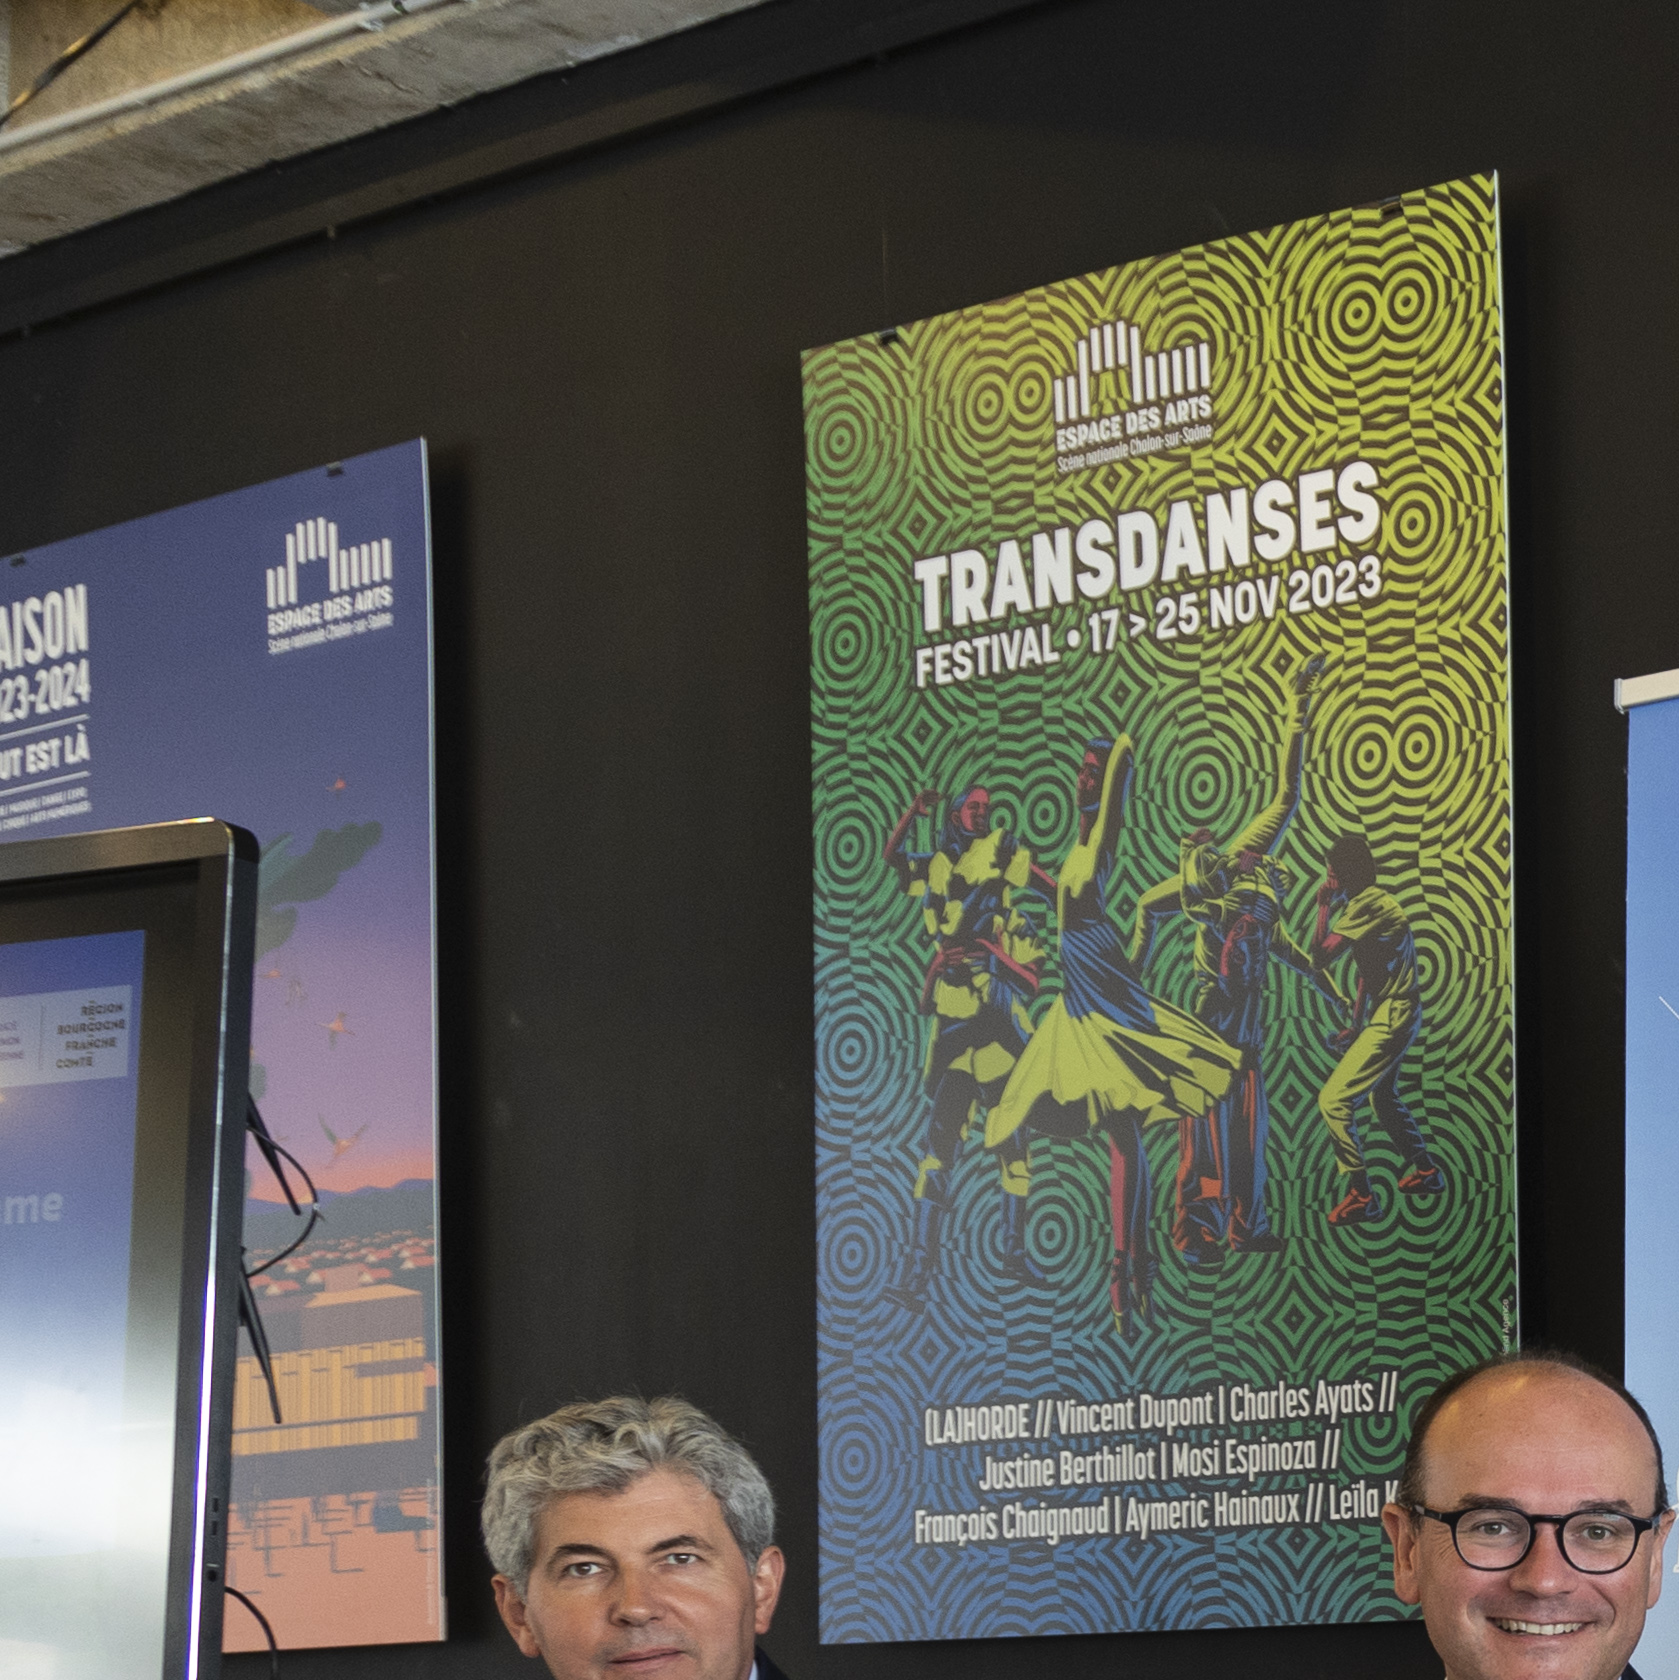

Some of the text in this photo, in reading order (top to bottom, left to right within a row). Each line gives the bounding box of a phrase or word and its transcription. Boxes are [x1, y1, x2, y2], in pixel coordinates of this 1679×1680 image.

[1056, 394, 1212, 451] ESPACE DES ARTS
[1057, 424, 1212, 473] Scène nationale Chalon-sur-Saône
[915, 461, 1381, 632] TRANSDANSES
[267, 585, 394, 635] ESPACE DES ARTS
[916, 624, 1059, 688] FESTIVAL
[1089, 608, 1119, 652] 17
[1155, 598, 1200, 641] 25
[1209, 575, 1281, 629] NOV
[1289, 555, 1382, 613] 2023
[25, 737, 62, 775] EST
[64, 723, 90, 765] LÀ
[1056, 1398, 1134, 1435] Vincent
[1140, 1392, 1213, 1436] Dupont
[1230, 1380, 1310, 1423] Charles
[1314, 1379, 1374, 1424] Ayats
[979, 1453, 1054, 1490] Justine
[1060, 1443, 1156, 1485] Berthillot
[1172, 1439, 1220, 1478] Mosi
[1225, 1436, 1316, 1482] Espinoza
[915, 1506, 998, 1547] François
[1002, 1496, 1109, 1545] Chaignaud
[1125, 1493, 1209, 1540] Aymeric
[1213, 1489, 1300, 1527] Hainaux
[1329, 1480, 1379, 1520] Leïla
